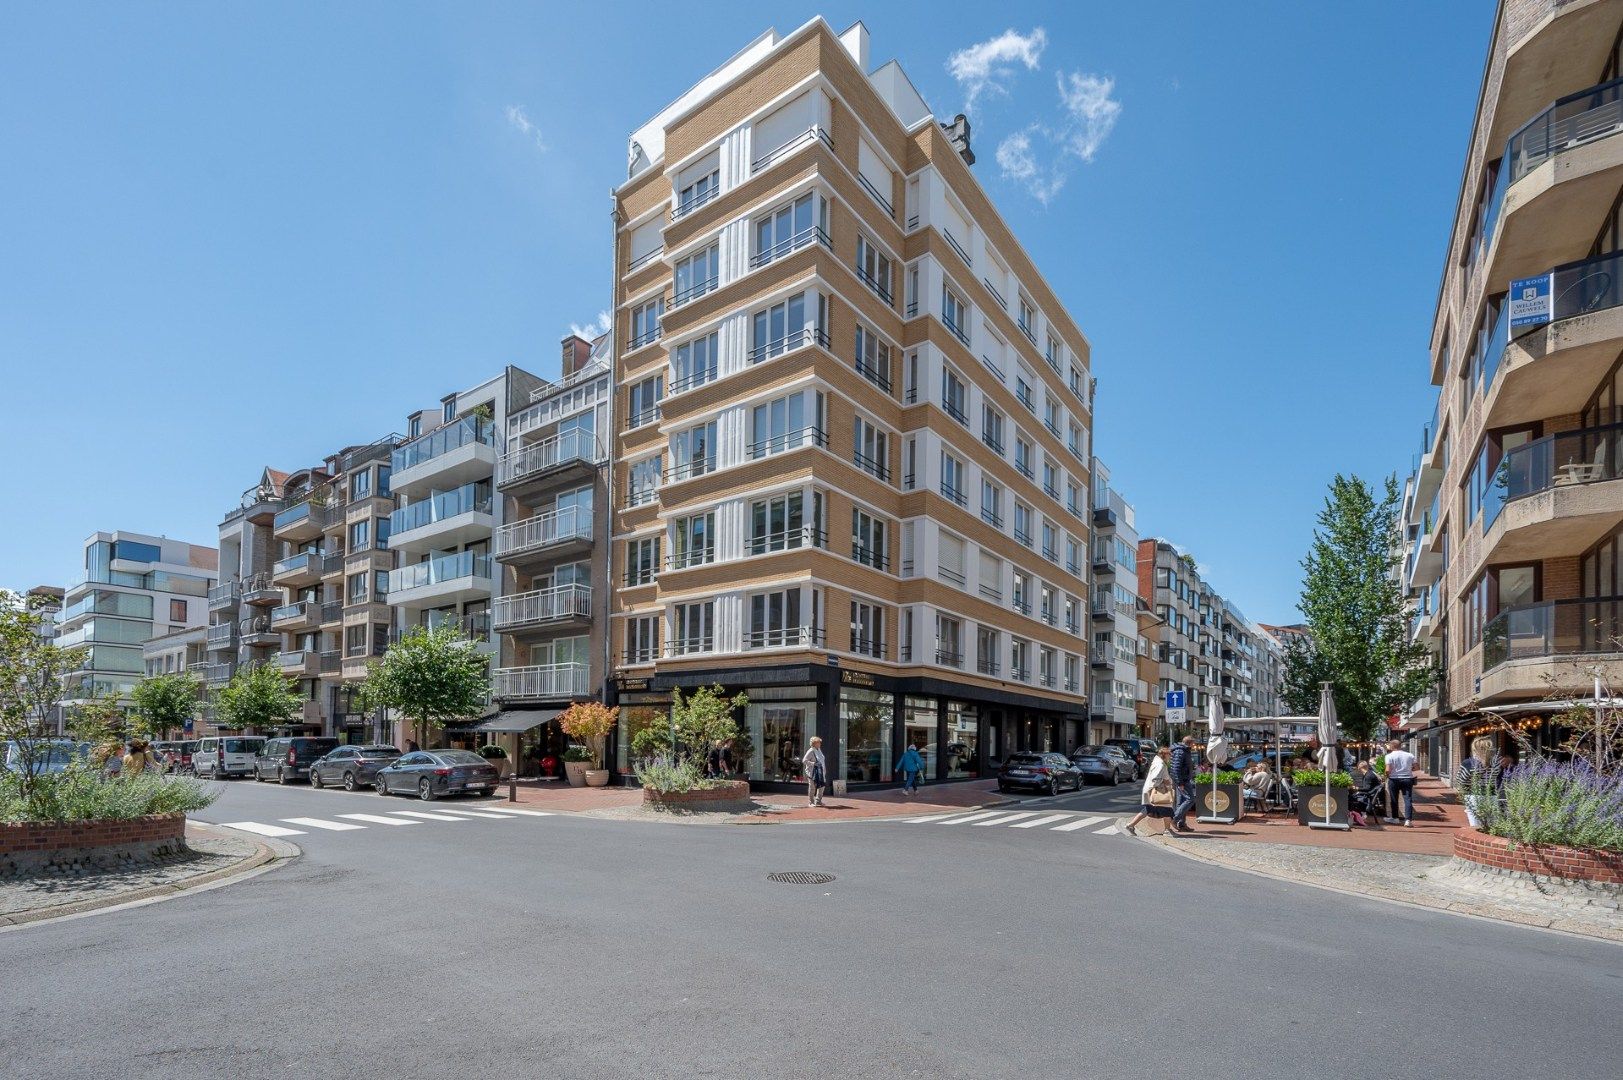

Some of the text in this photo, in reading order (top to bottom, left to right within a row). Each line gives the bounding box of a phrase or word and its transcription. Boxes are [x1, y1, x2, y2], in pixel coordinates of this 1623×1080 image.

[1526, 277, 1548, 285] KOOP
[1516, 300, 1543, 308] WILLEM
[1513, 305, 1546, 314] CAUWELS
[185, 719, 192, 727] P
